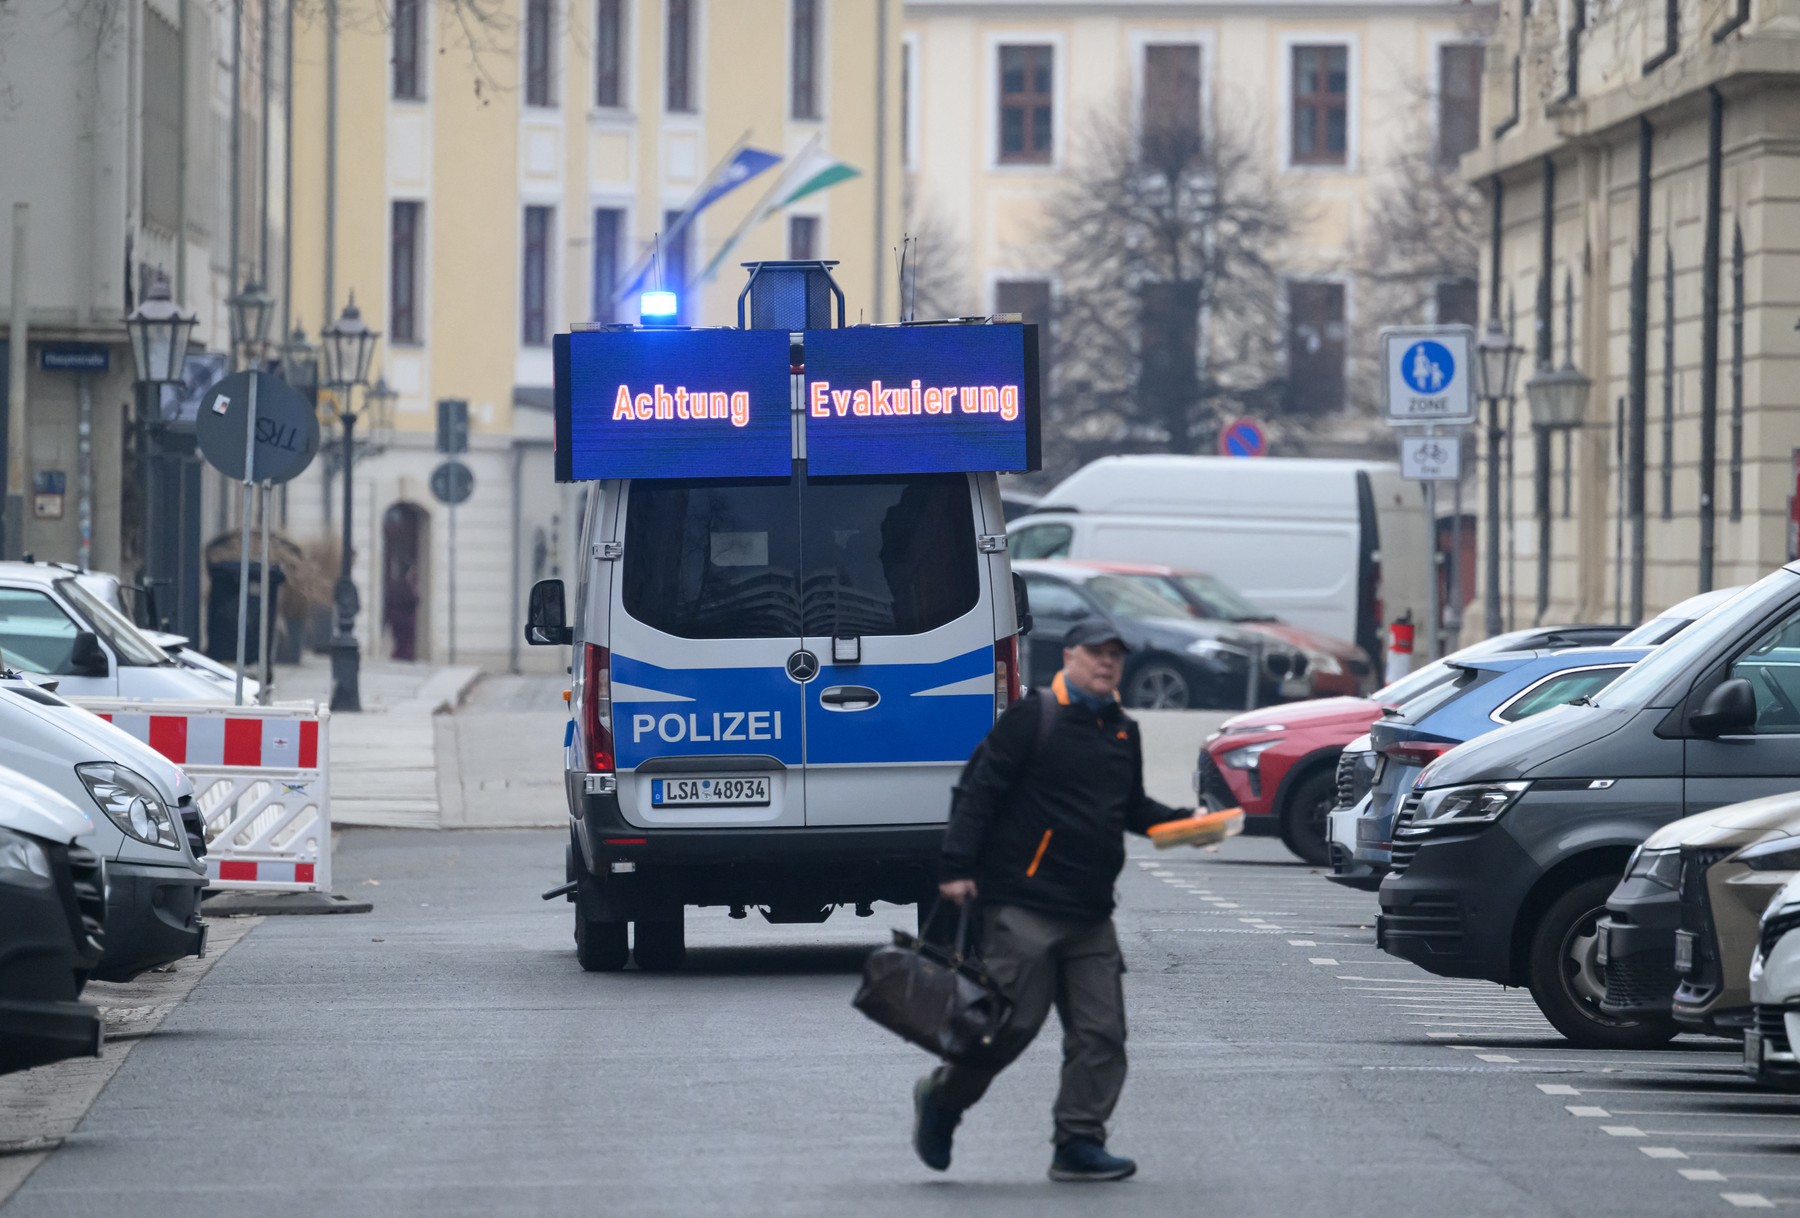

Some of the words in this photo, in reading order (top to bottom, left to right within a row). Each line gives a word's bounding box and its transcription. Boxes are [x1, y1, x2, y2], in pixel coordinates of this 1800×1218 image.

[612, 384, 749, 427] Achtung
[810, 380, 1018, 421] Evakuierung
[1408, 397, 1449, 412] ZONE
[633, 711, 782, 743] POLIZEI
[667, 781, 699, 800] LSA
[713, 780, 765, 799] 48934
